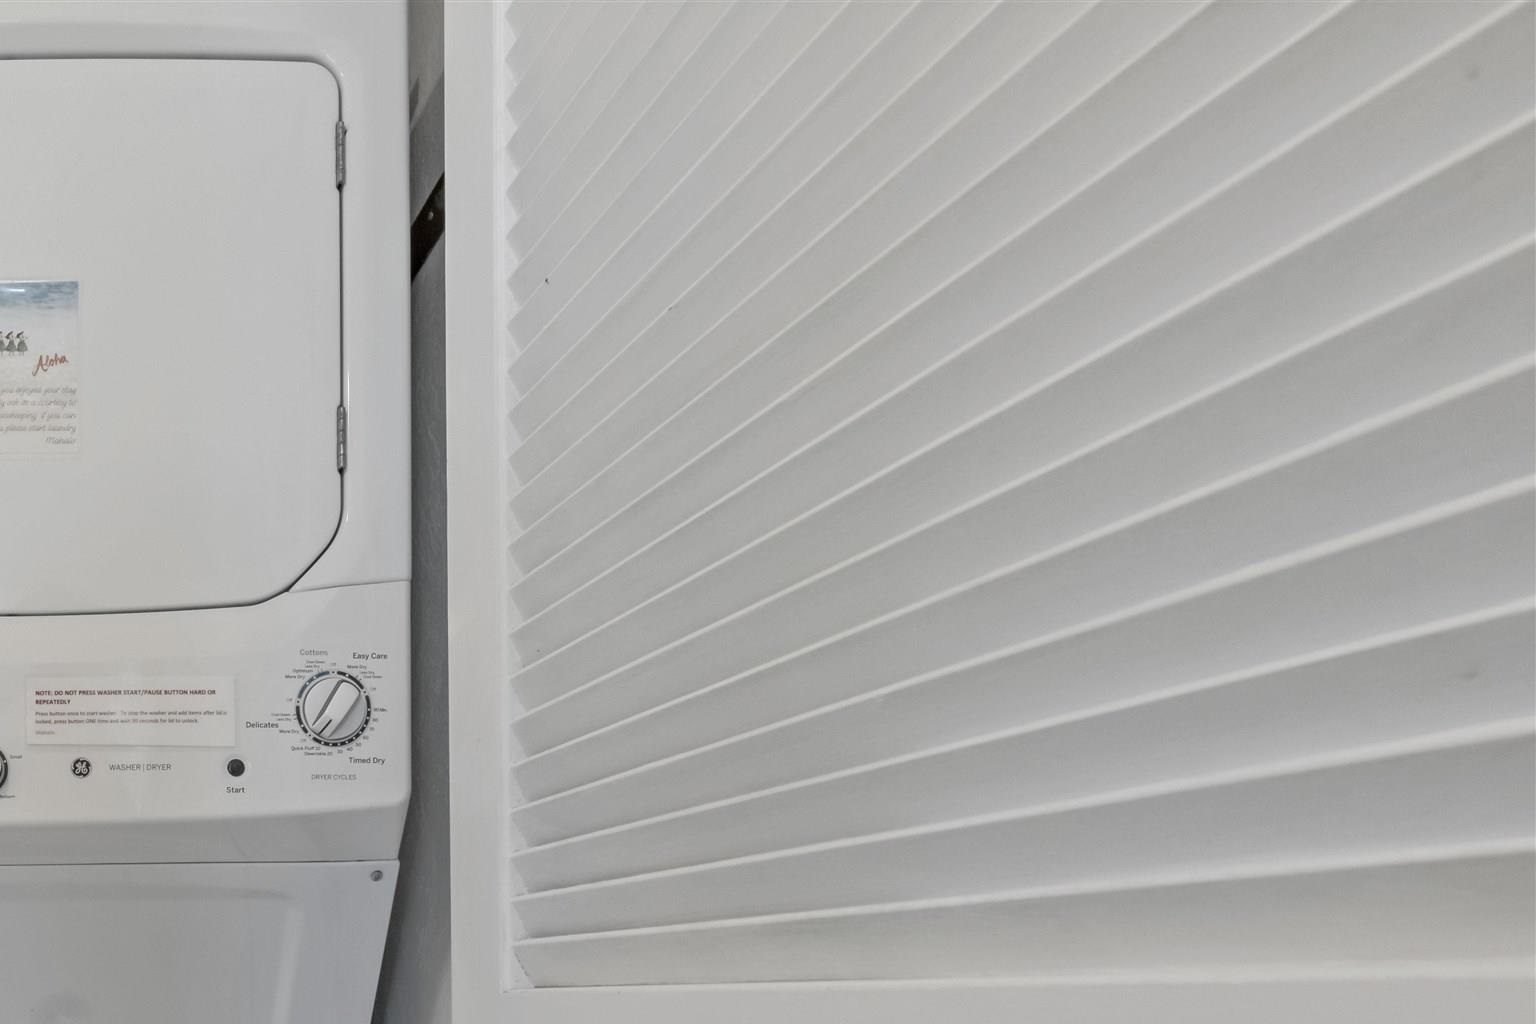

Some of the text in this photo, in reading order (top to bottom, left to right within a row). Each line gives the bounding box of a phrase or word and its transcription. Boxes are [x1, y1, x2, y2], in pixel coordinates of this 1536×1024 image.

[32, 353, 69, 376] Aloha
[349, 757, 386, 765] Timed Dry
